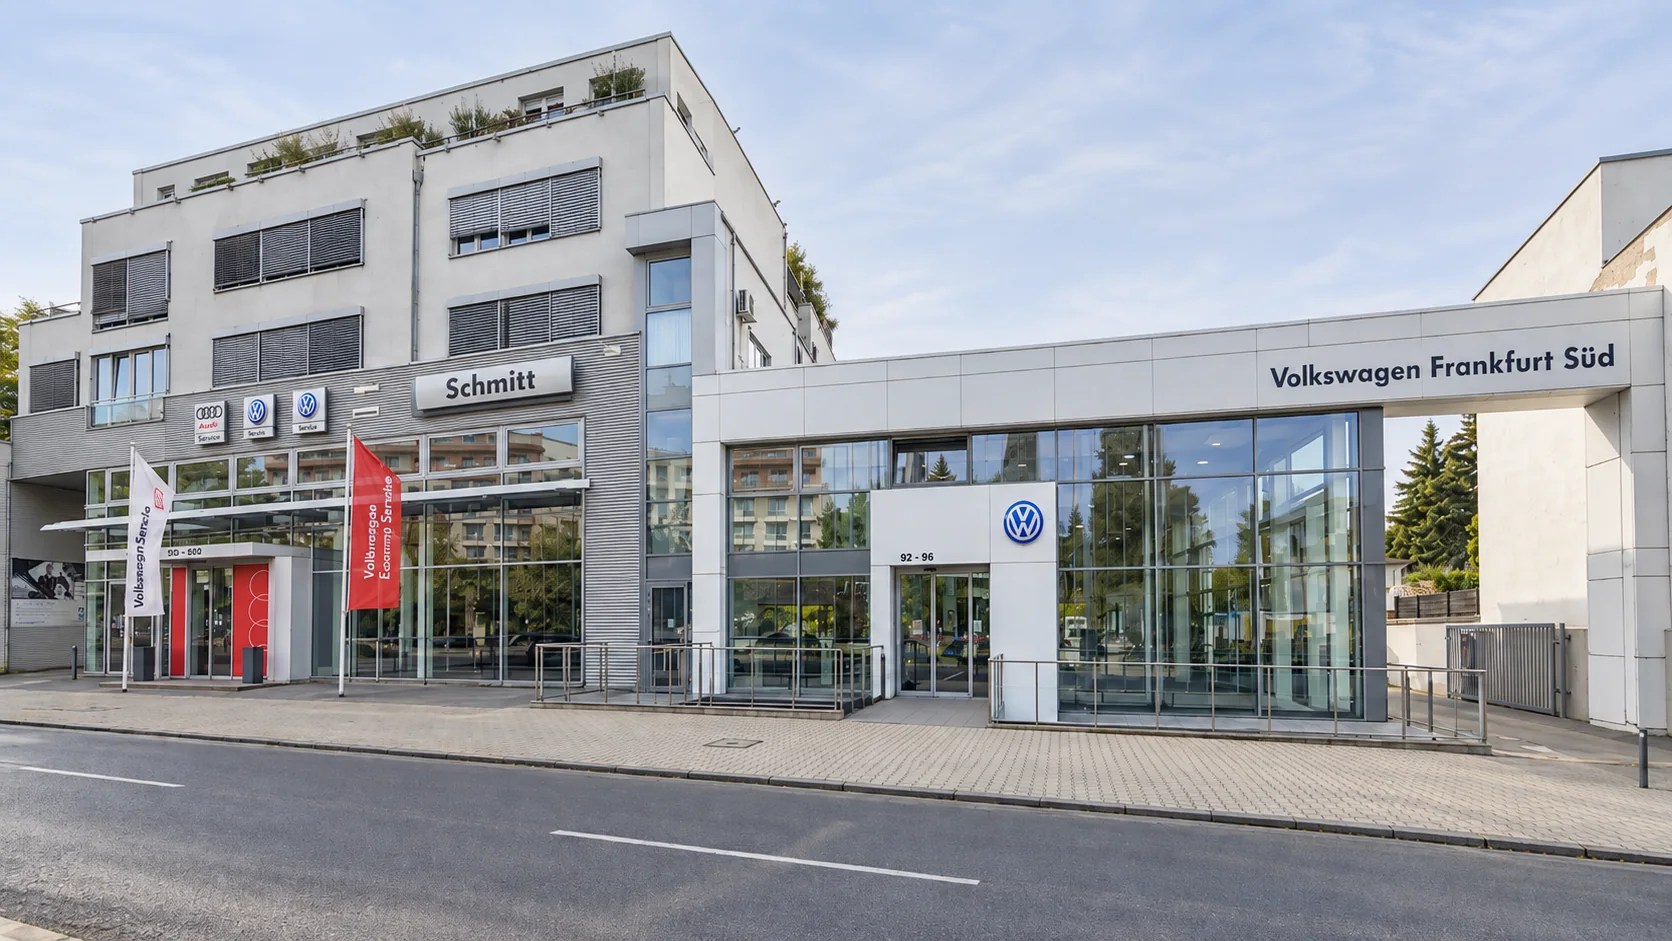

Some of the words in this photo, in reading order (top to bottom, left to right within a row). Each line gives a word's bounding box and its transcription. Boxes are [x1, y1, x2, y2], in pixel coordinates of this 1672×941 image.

[1270, 363, 1421, 388] Volkswagen
[1430, 350, 1554, 378] Frankfurt
[1563, 343, 1615, 370] Süd
[446, 370, 536, 399] Schmitt
[1004, 500, 1044, 544] VW
[900, 553, 912, 562] 92
[921, 552, 934, 562] 96
